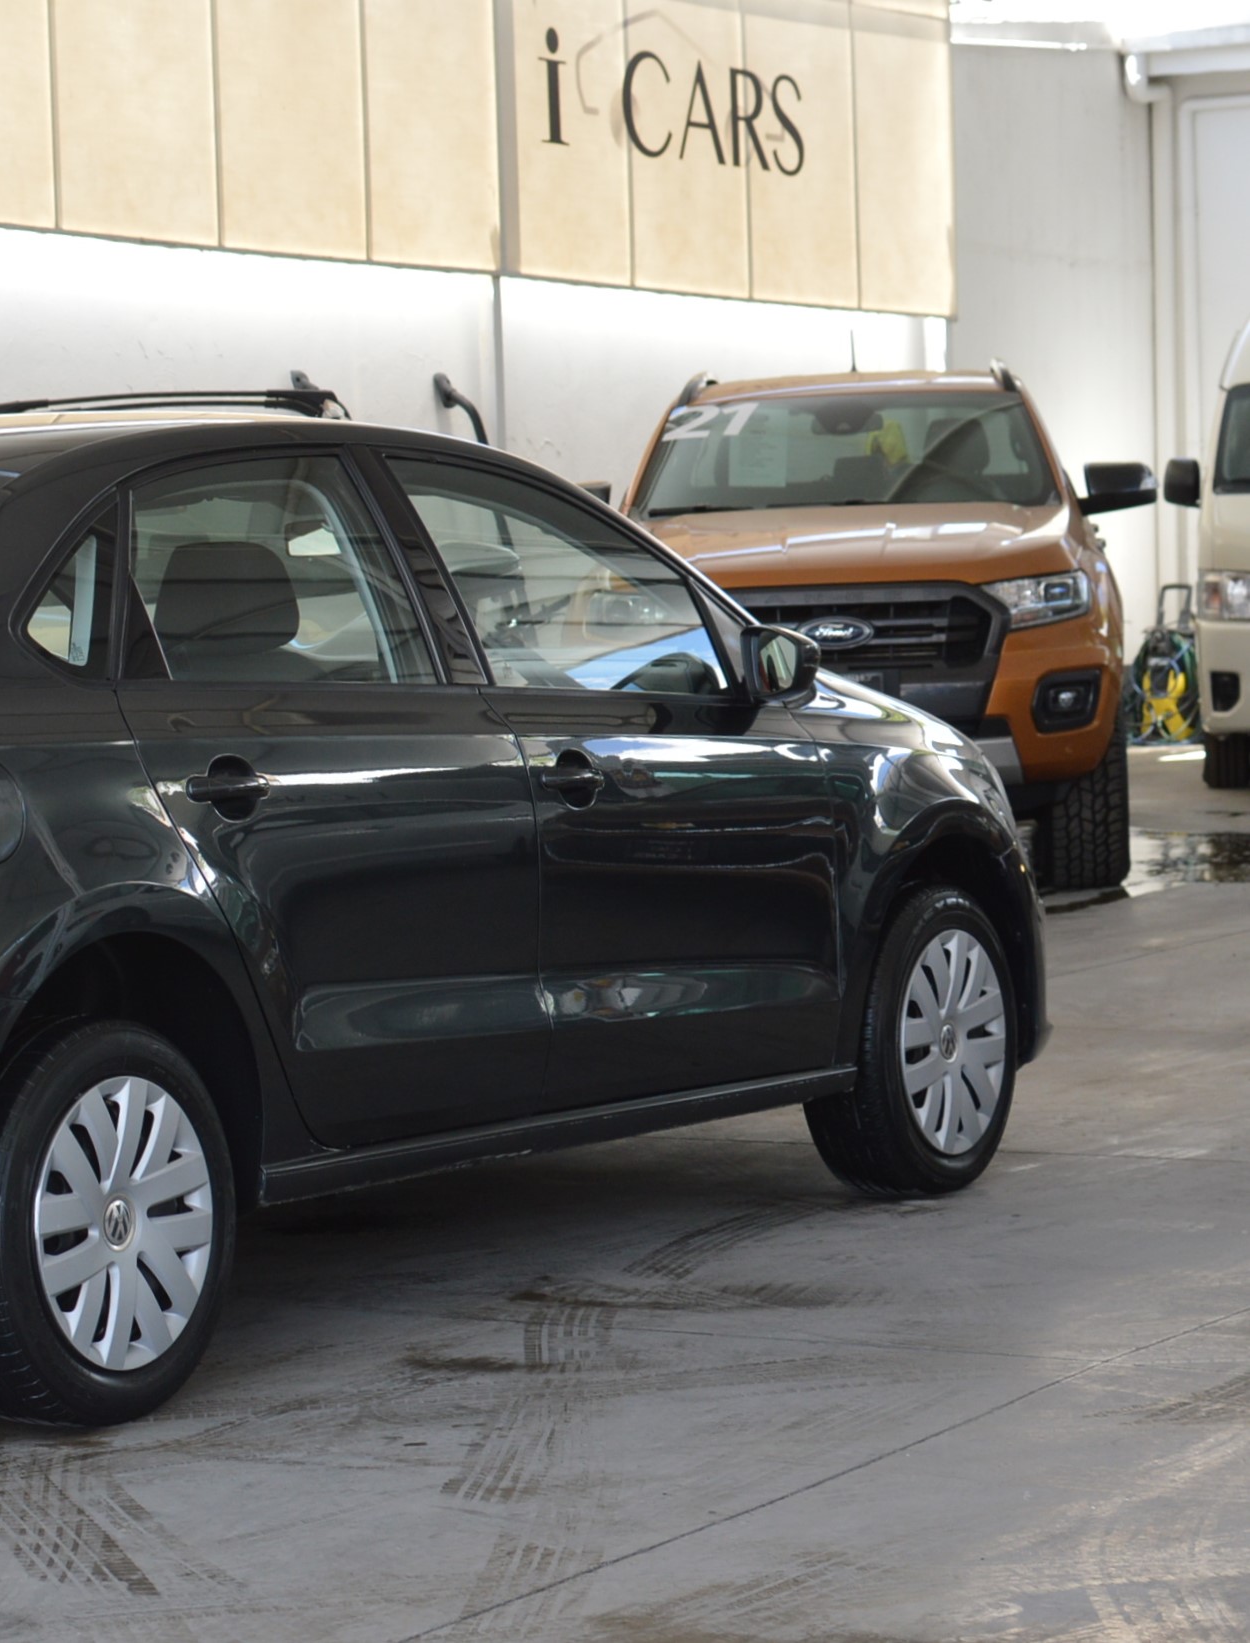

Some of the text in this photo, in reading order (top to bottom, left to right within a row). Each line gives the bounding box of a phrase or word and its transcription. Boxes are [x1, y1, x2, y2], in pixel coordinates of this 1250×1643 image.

[538, 27, 805, 177] i CARS
[661, 402, 760, 442] 21
